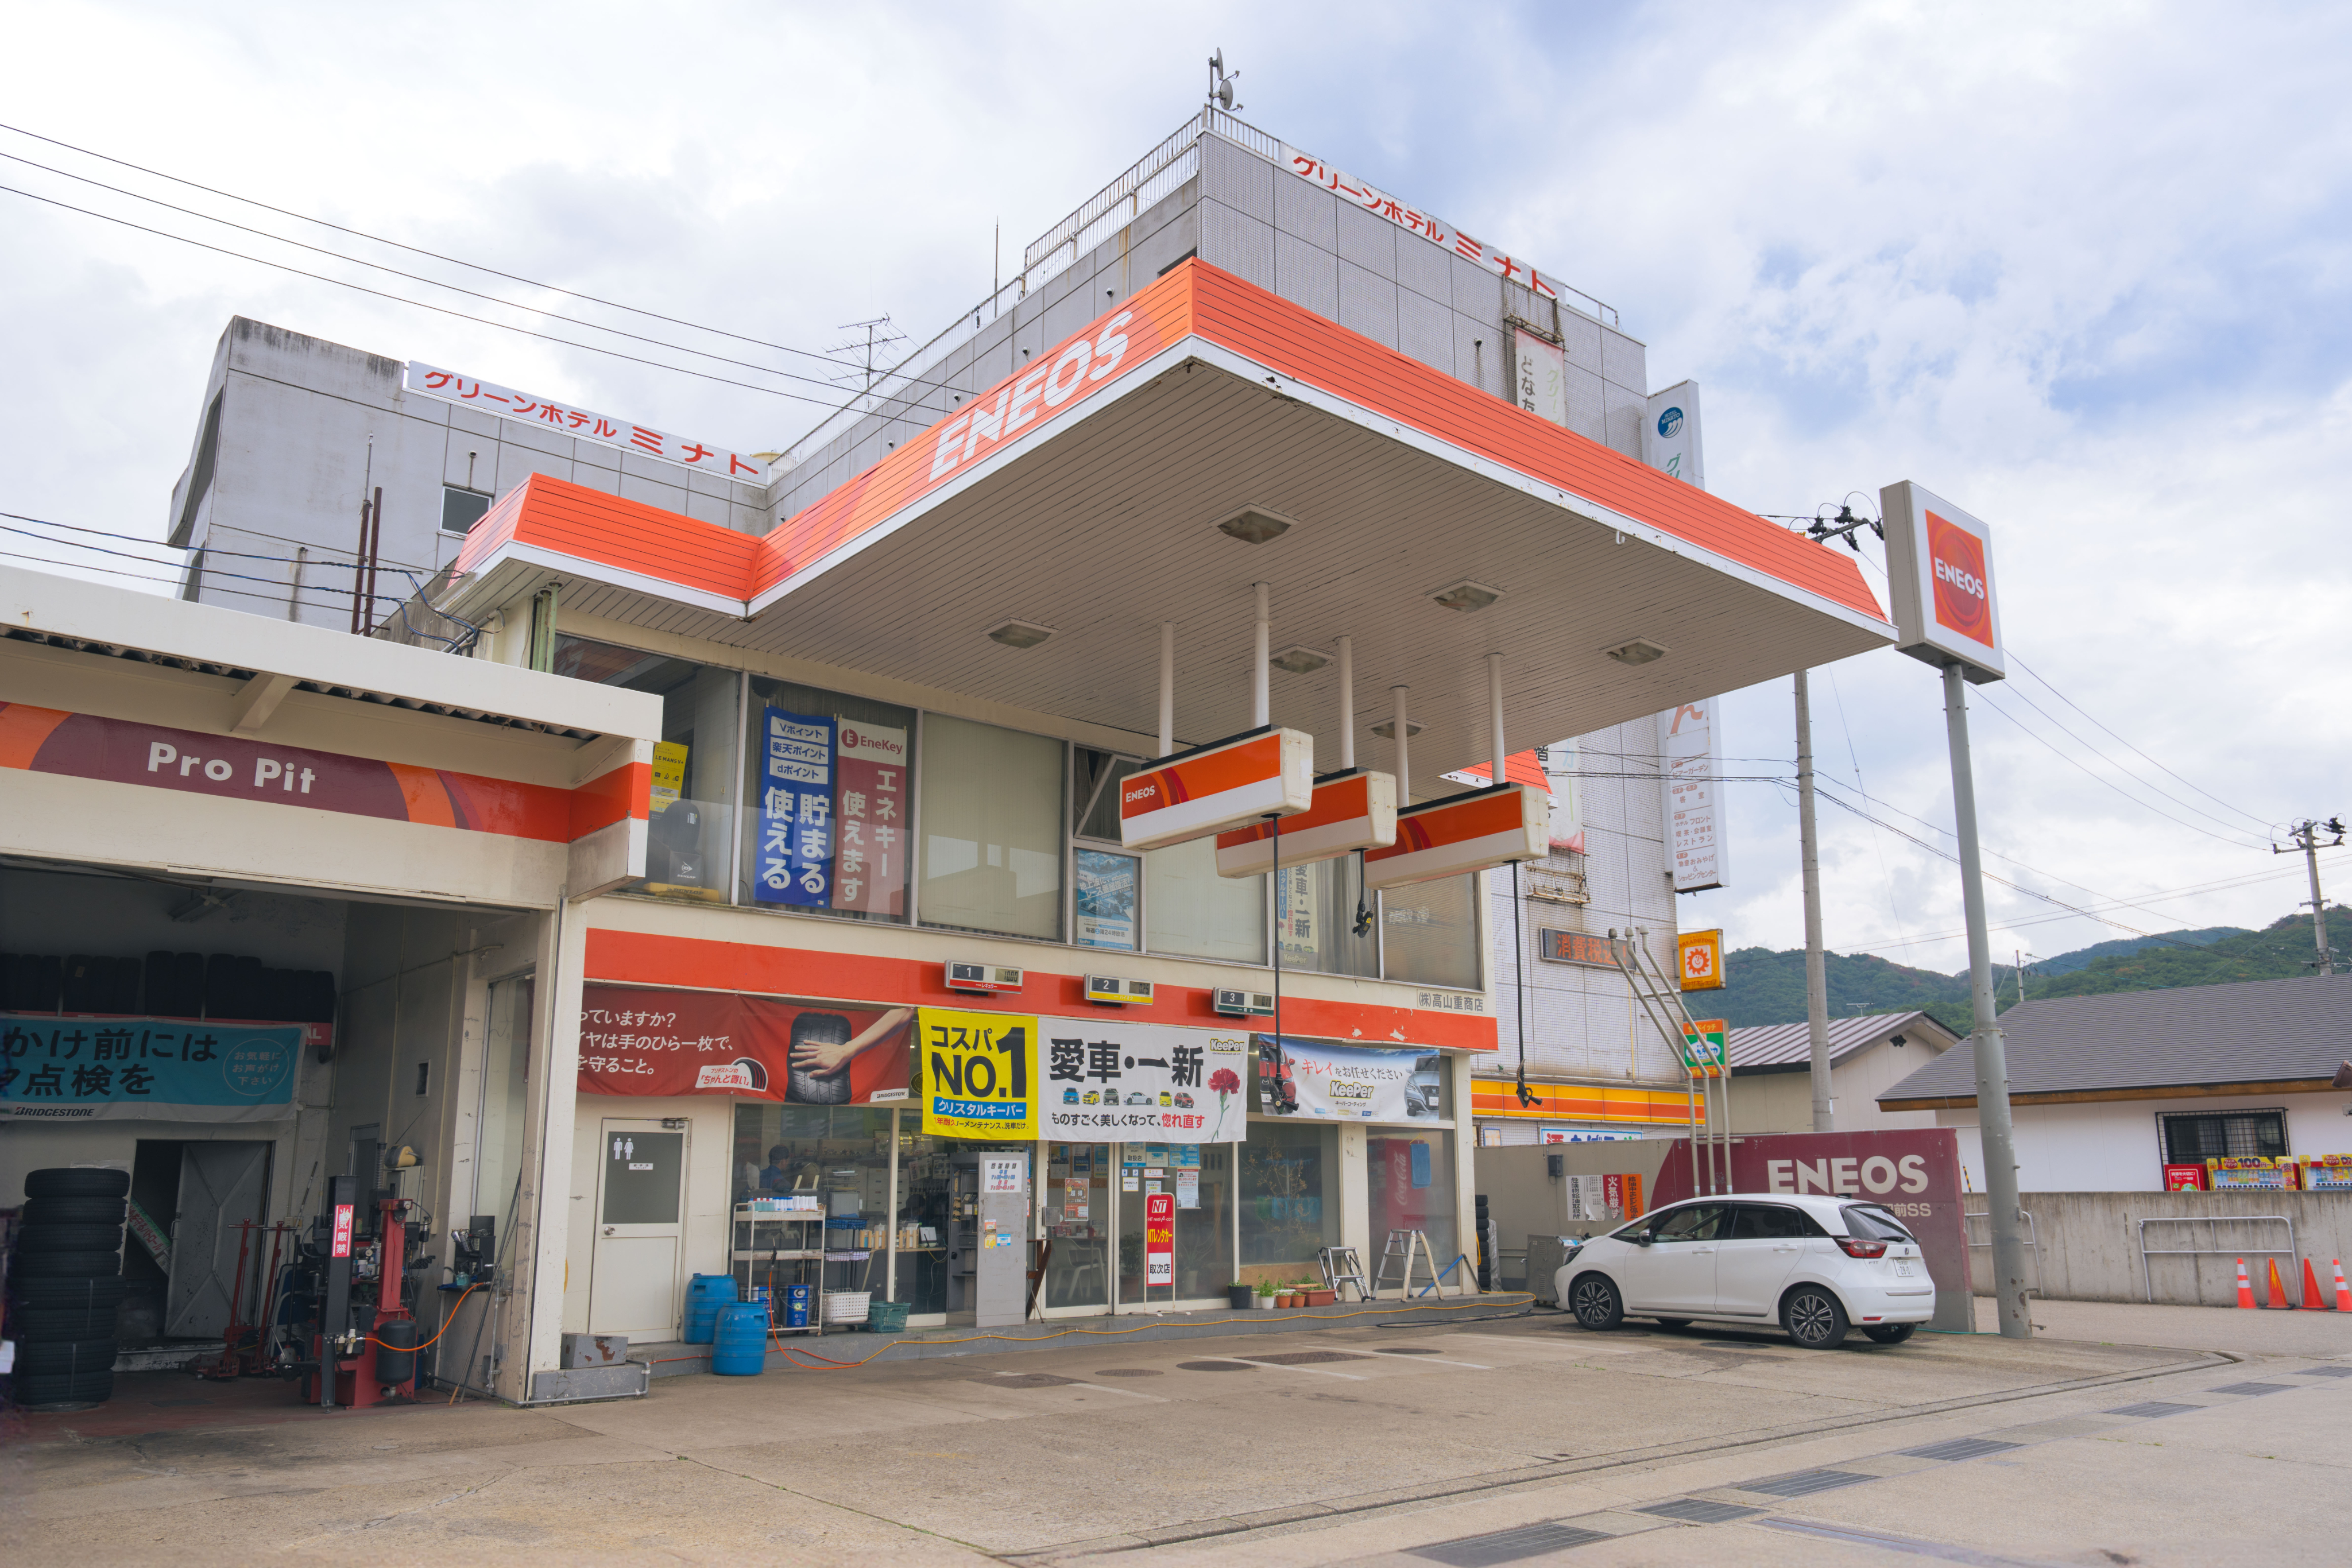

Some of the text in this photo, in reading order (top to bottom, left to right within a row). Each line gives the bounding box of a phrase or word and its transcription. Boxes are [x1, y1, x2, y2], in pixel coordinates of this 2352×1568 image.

[1293, 156, 1556, 296] グリーンホテル ミナト
[929, 311, 1132, 482] ENEOS
[1661, 413, 1680, 424] MINATO
[1664, 410, 1677, 418] HOTEL
[425, 371, 759, 475] グリーンホテル ミナト
[1935, 557, 1984, 599] ENEOS
[780, 723, 822, 738] Vポイント
[773, 742, 826, 760] 楽天ポイント
[861, 735, 903, 754] EneKey
[147, 741, 316, 794] Pro Pit
[777, 765, 819, 779] dポイント
[1126, 785, 1155, 803] ENEOS
[875, 771, 897, 877] エネキー
[1690, 816, 1711, 825] フロント
[763, 786, 794, 889] 使える
[799, 792, 830, 893] 貯まる
[1677, 835, 1712, 847] レストラン
[842, 791, 866, 902] 使えます
[1678, 854, 1715, 868] 物産おみやげ
[1678, 870, 1716, 882] ショッピングセンター
[1284, 953, 1307, 964] KeePer
[967, 967, 971, 977] 1
[1104, 980, 1109, 989] 2
[1230, 993, 1235, 1002] 3
[1419, 992, 1483, 1012] (株)高山重商店
[1688, 1024, 1716, 1032] サドイッチ
[931, 1025, 992, 1052] コスパ
[1210, 1039, 1244, 1051] KeePer
[234, 1051, 281, 1061] お気軽に
[931, 1027, 1026, 1098] NO.1
[1050, 1038, 1204, 1088] 愛車・一新
[233, 1063, 280, 1073] お声がけ
[1302, 1059, 1403, 1080] キレイをお任せください
[238, 1077, 272, 1086] 下さい
[701, 1074, 749, 1086] 「ちゃんと買い」
[1330, 1080, 1374, 1098] KeePer
[15, 1107, 94, 1116] BRIDGESTONE
[938, 1100, 1023, 1116] クリスタルキーパー
[1052, 1112, 1205, 1129] ものすごく美しくなって、惚れ直す
[1767, 1155, 1928, 1194] ENEOS
[2284, 1163, 2291, 1171] 肉
[1571, 1177, 1580, 1219] 危険物給油取扱所
[1608, 1176, 1620, 1218] 火気厳禁
[1628, 1176, 1638, 1219] 給油中エンジン停止
[1152, 1200, 1167, 1213] NT
[1148, 1229, 1172, 1243] NTレンタカー
[1150, 1264, 1170, 1274] 取次店
